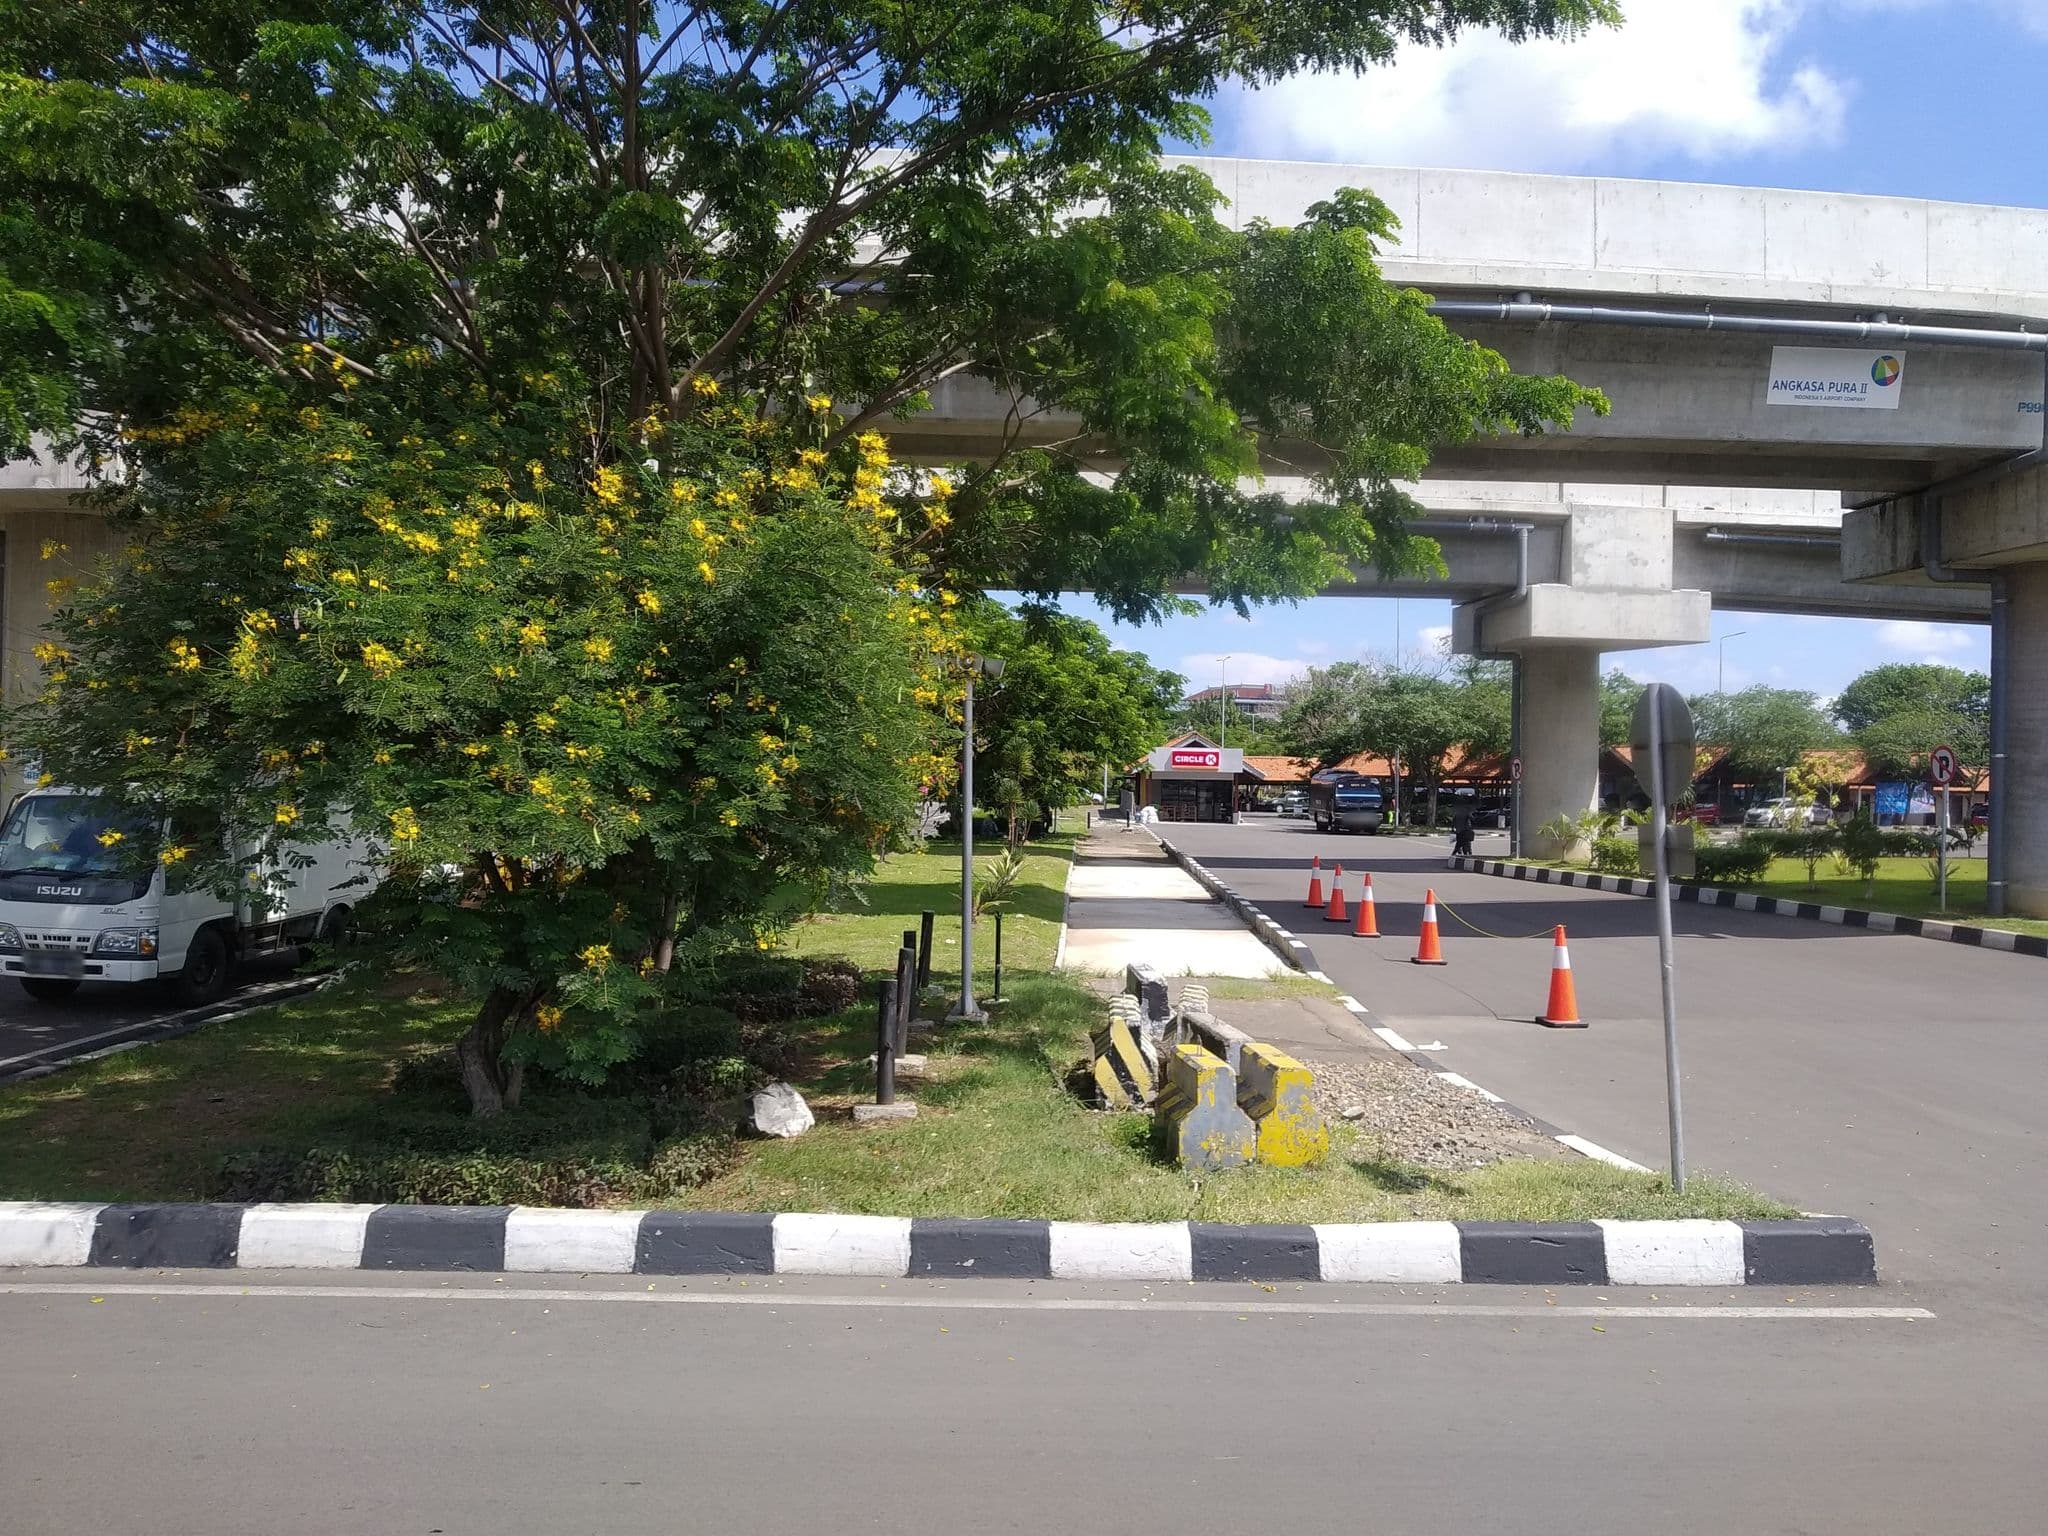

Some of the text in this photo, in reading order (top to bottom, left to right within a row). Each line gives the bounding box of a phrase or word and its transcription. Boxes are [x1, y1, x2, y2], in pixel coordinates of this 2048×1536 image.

[1772, 379, 1868, 394] ANGKASA PURA II
[1174, 755, 1205, 763] CIRCLE
[1939, 755, 1950, 779] P
[37, 886, 82, 896] ISUZU
